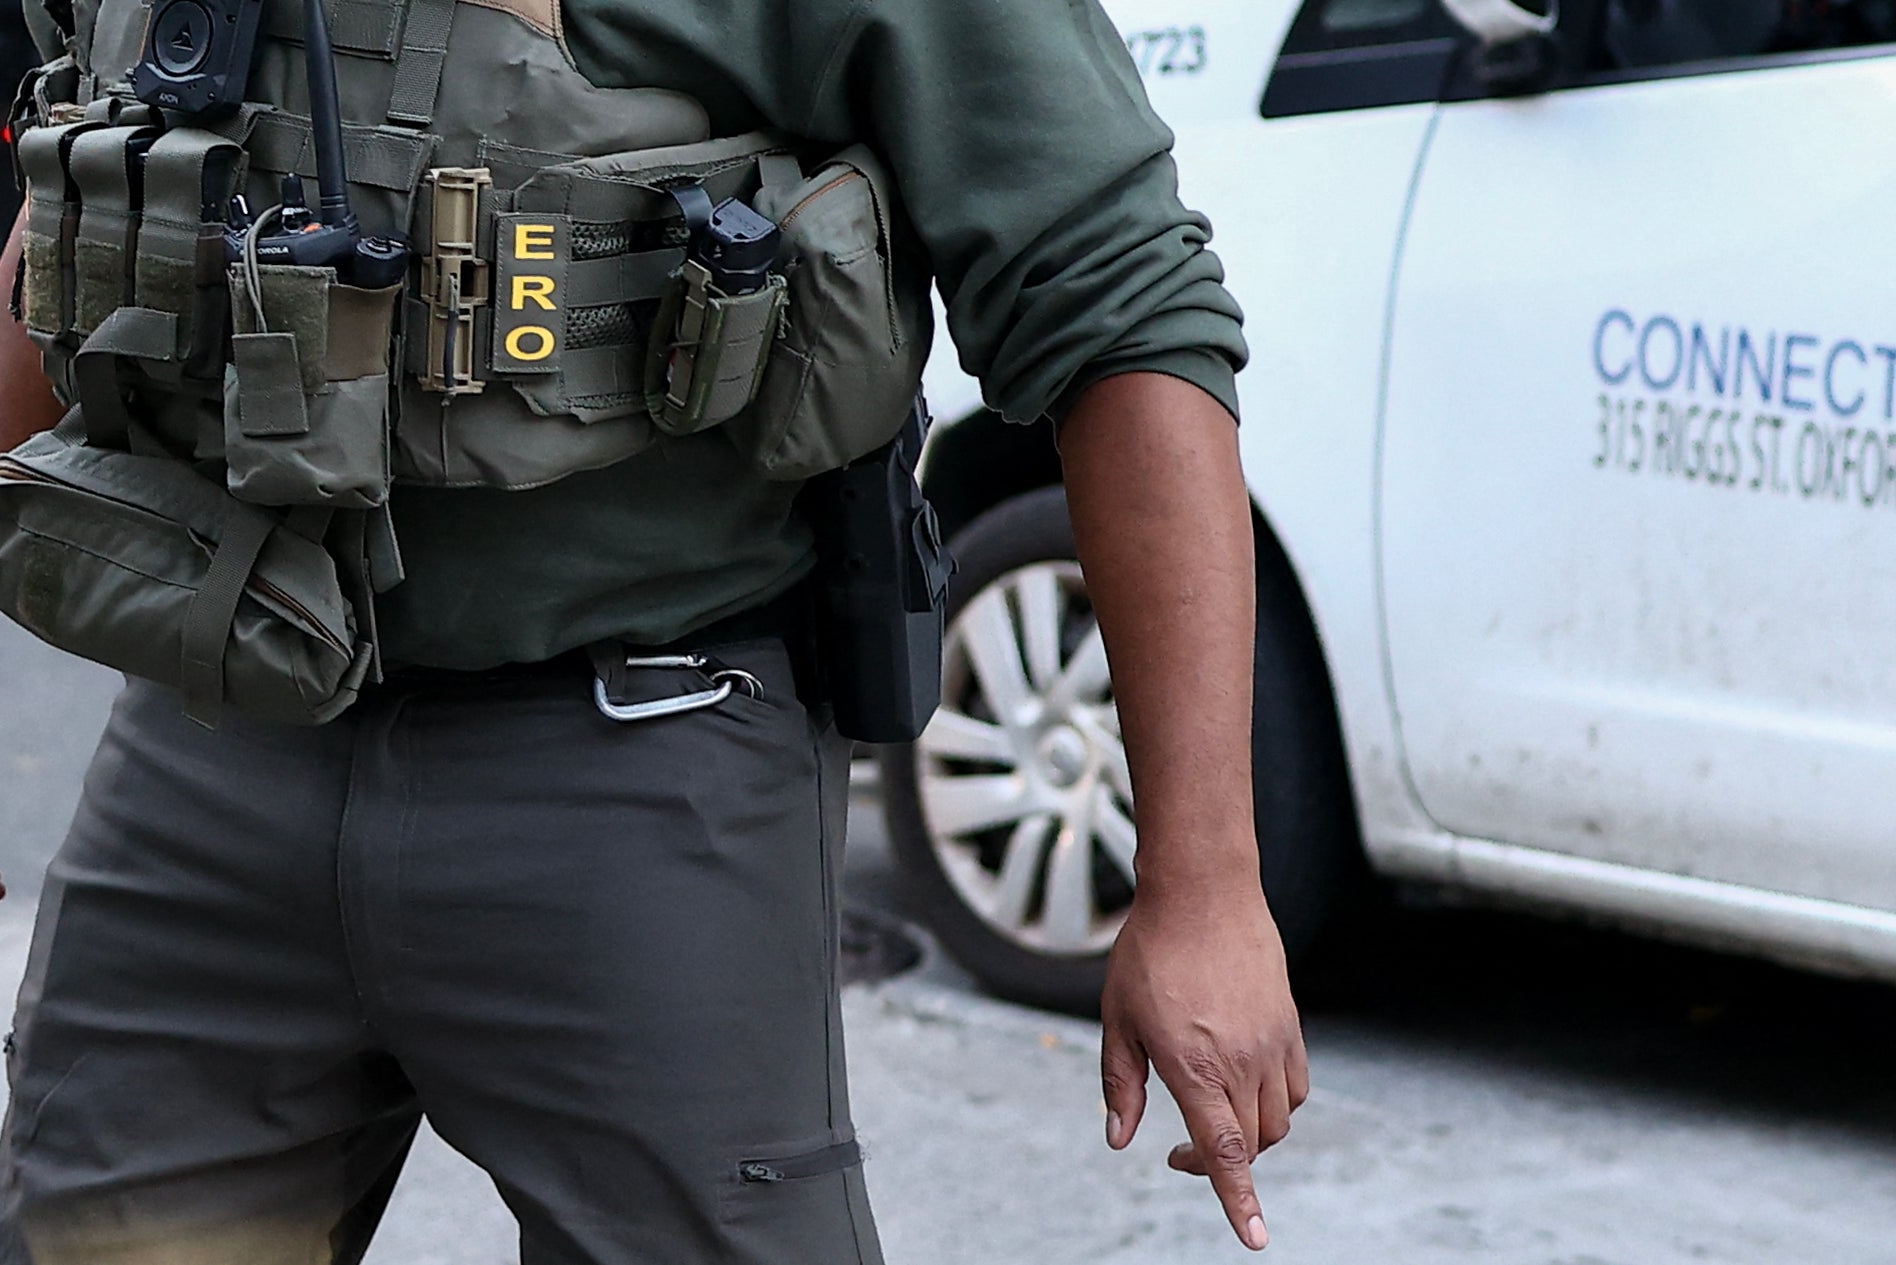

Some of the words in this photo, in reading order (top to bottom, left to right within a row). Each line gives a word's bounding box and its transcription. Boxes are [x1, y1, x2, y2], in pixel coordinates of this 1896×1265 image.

[1126, 27, 1207, 75] 723
[505, 223, 557, 361] ERO
[1593, 308, 1896, 420] CONNECT
[1592, 394, 1645, 473] 315
[1655, 400, 1741, 486] RIGGS
